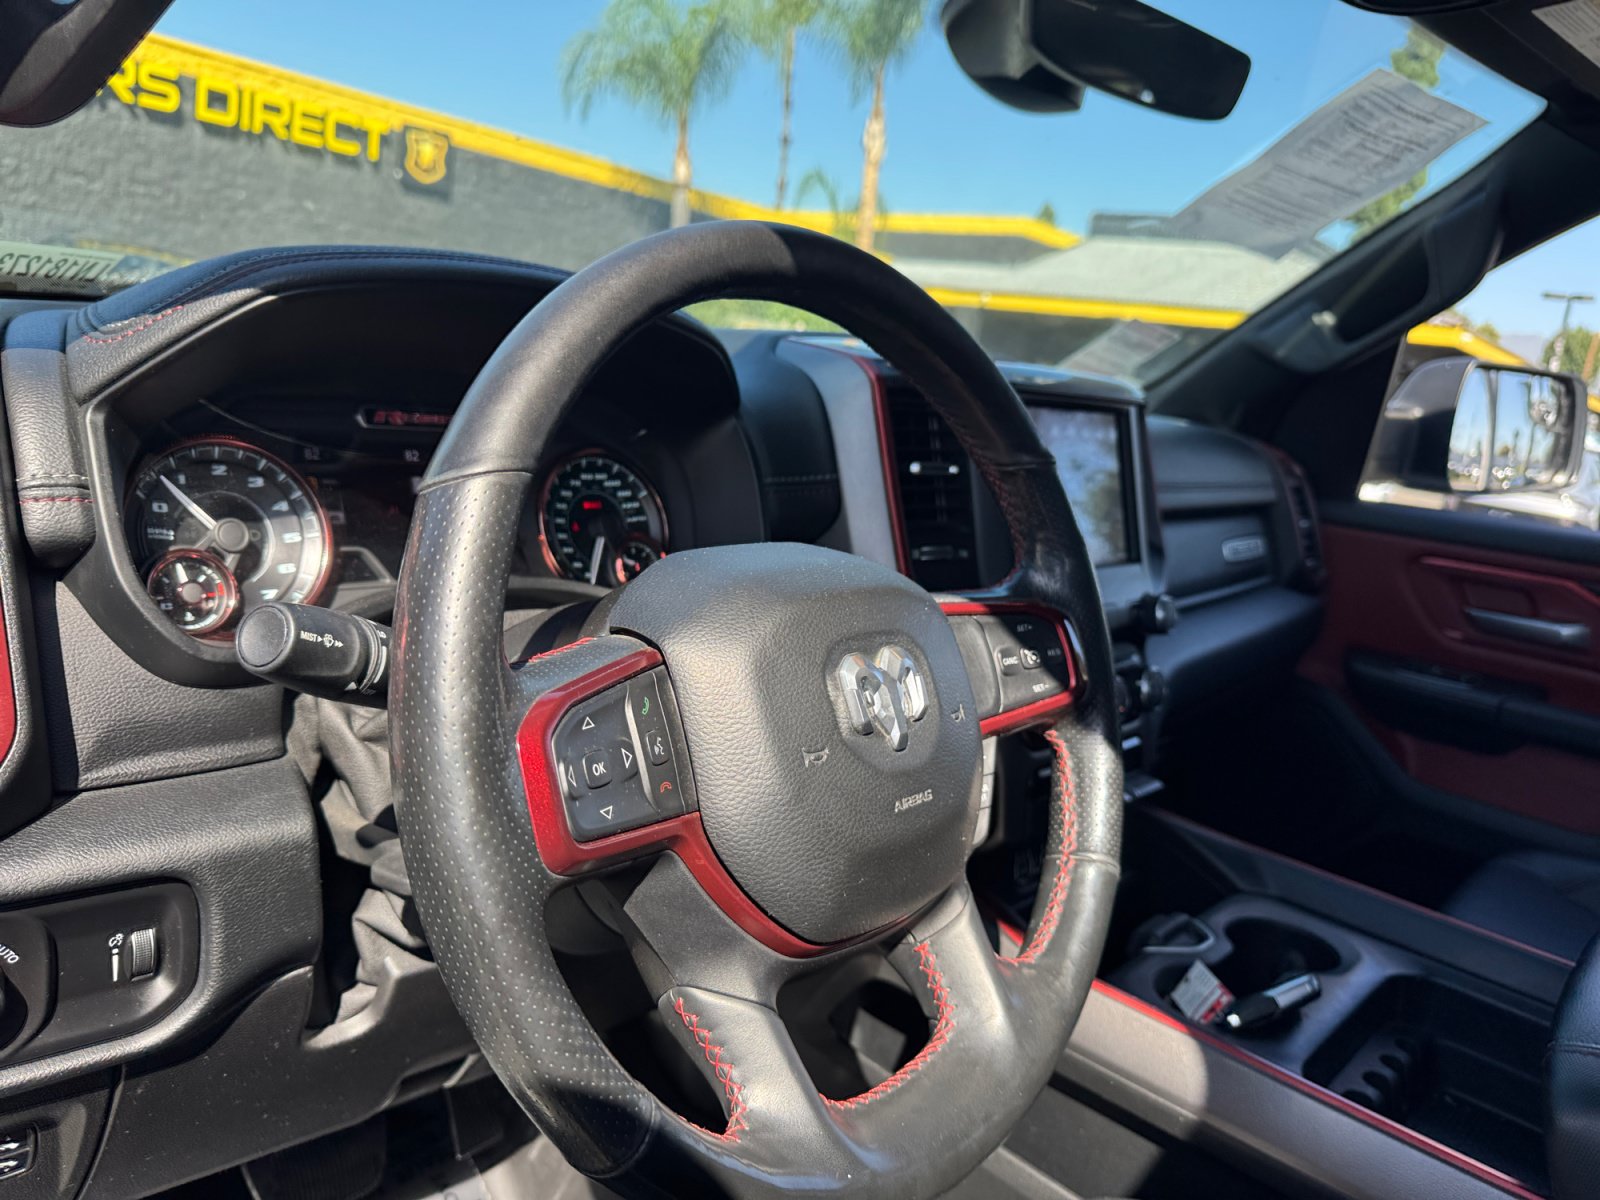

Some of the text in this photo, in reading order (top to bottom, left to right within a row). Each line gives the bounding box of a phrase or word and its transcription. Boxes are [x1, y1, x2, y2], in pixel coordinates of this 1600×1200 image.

[194, 74, 392, 163] DIRECT
[211, 464, 228, 476] 2
[177, 474, 186, 485] 1
[247, 476, 264, 488] 3
[152, 502, 169, 513] 0
[272, 501, 289, 512] 4
[282, 532, 302, 543] 5
[277, 563, 297, 574] 6
[260, 588, 279, 600] 7
[300, 630, 318, 643] MIST
[592, 761, 607, 776] OK
[894, 788, 933, 814] AIRBAG
[0, 944, 20, 964] UTO
